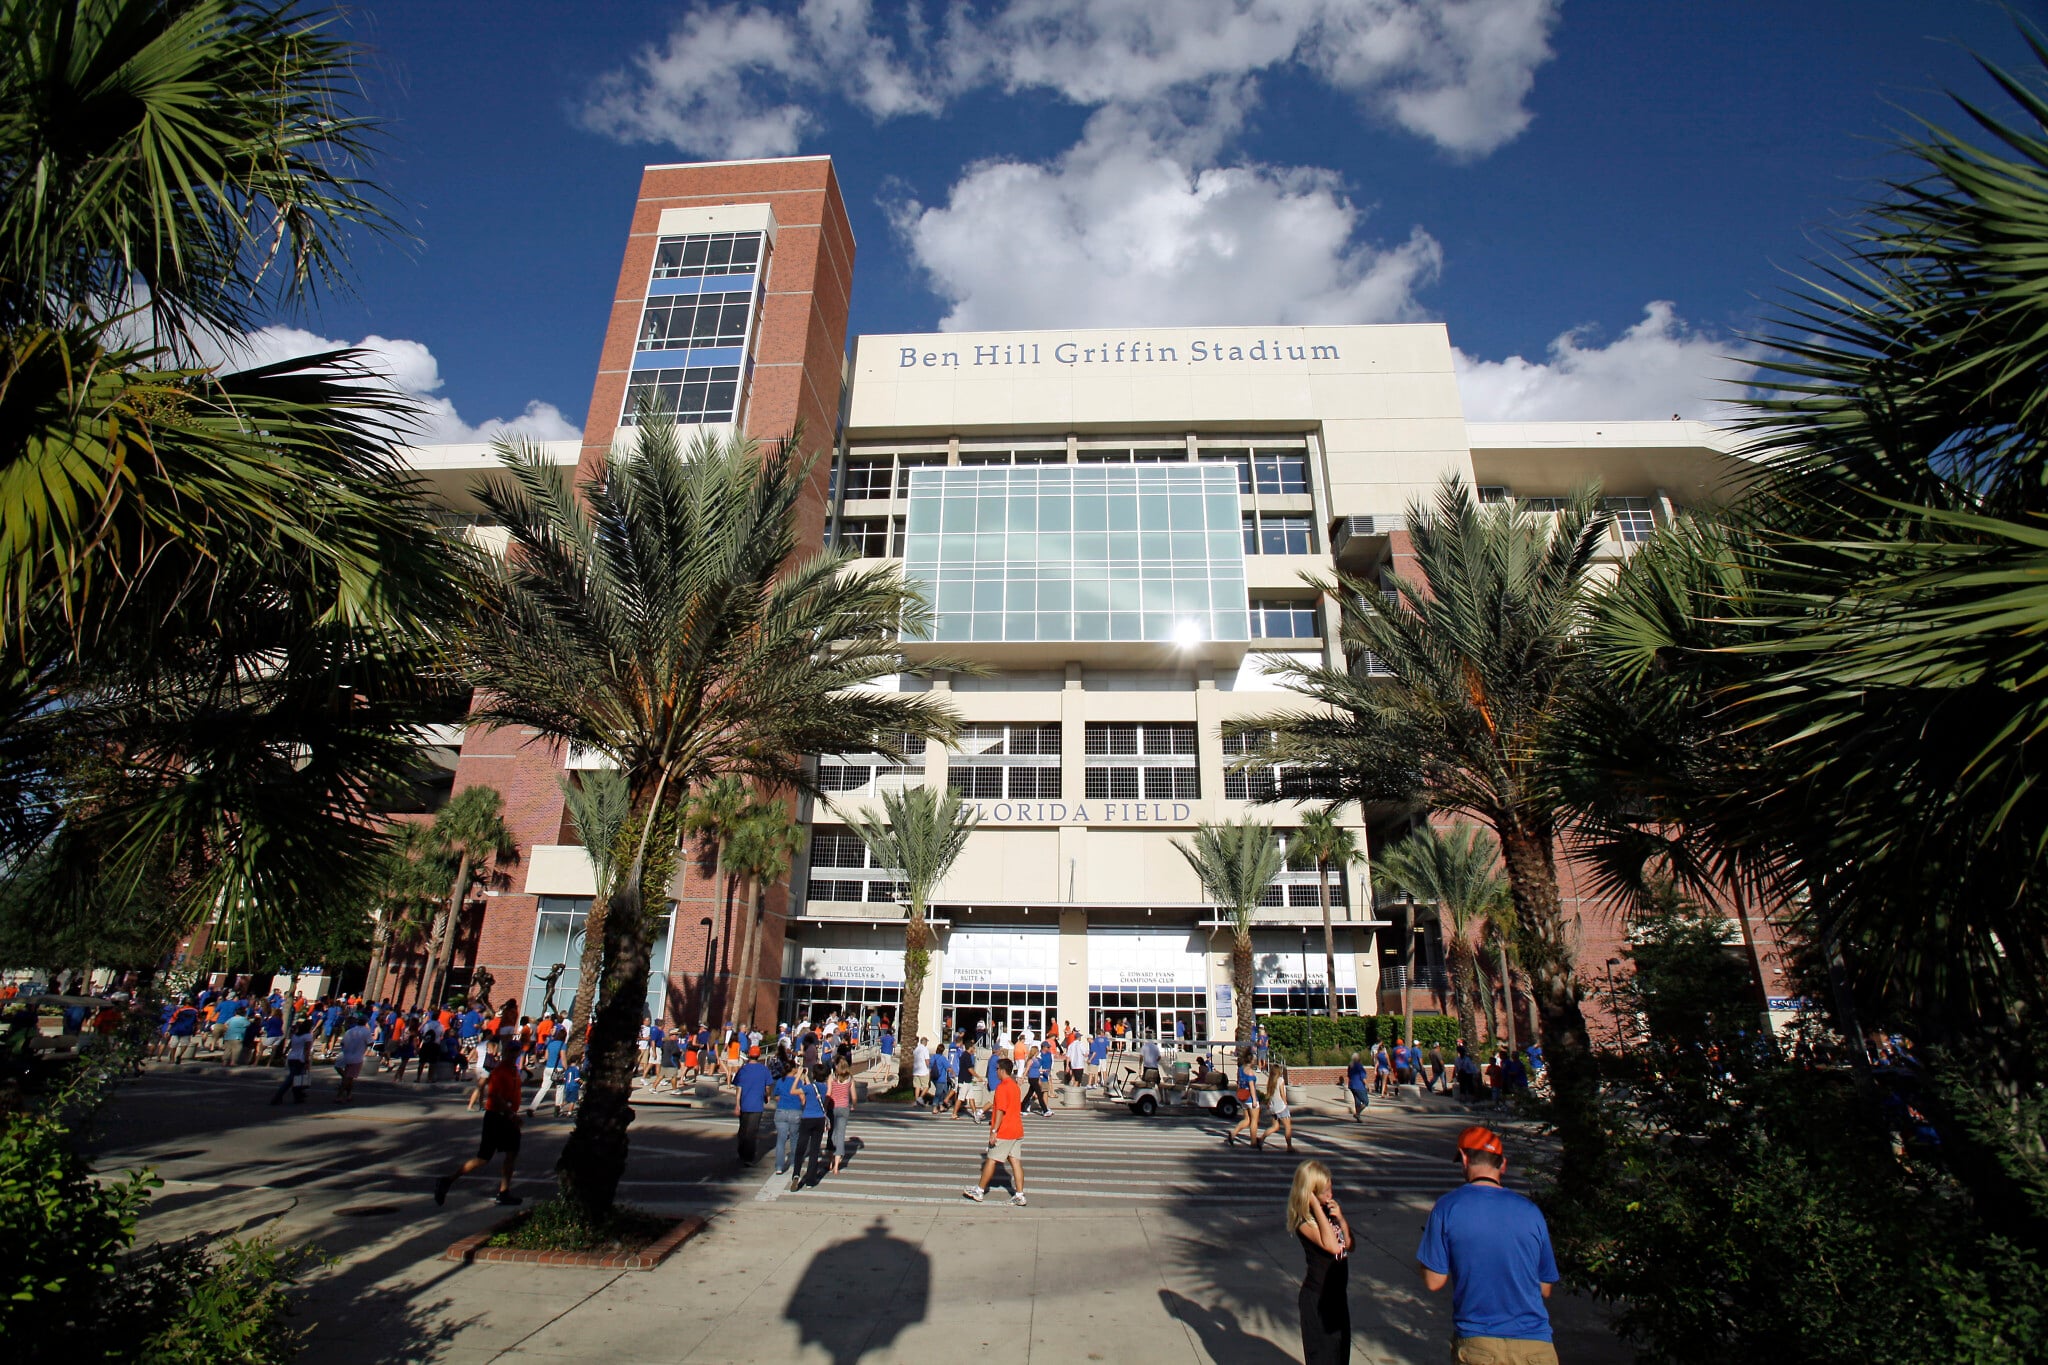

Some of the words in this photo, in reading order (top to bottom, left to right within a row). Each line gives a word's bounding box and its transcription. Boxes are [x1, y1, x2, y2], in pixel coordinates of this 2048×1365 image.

[899, 346, 961, 367] Ben
[973, 344, 1041, 365] Hill
[1055, 342, 1179, 363] Griffin
[1191, 340, 1341, 361] Stadium
[959, 803, 1090, 821] FLORIDA
[1104, 803, 1190, 821] FIELD
